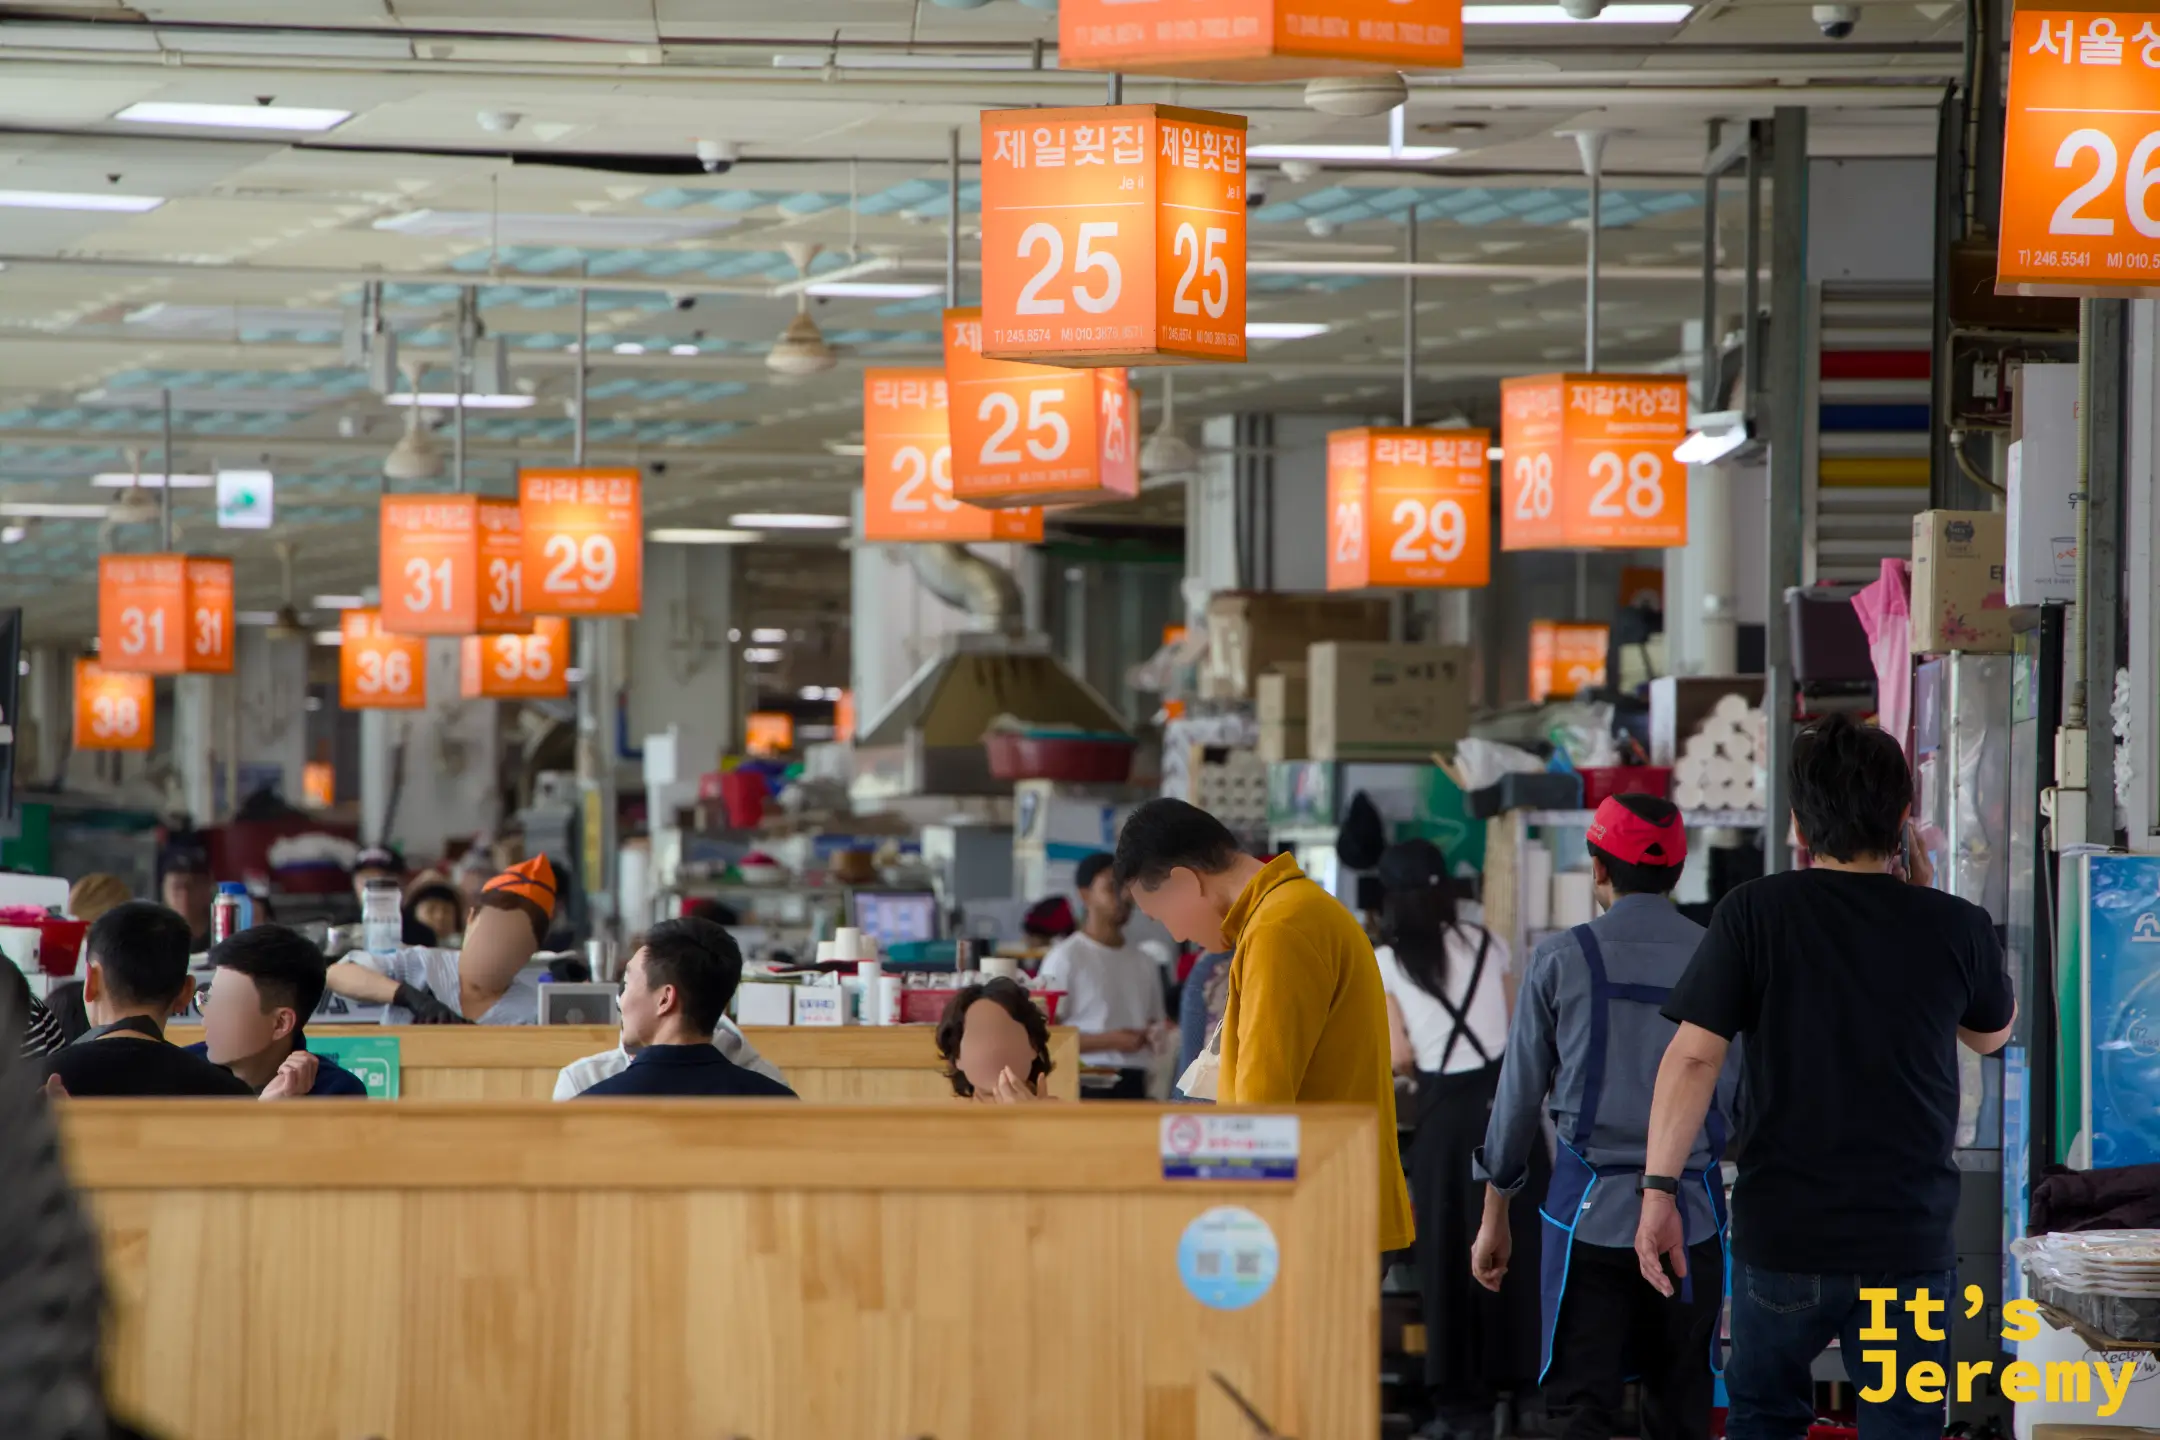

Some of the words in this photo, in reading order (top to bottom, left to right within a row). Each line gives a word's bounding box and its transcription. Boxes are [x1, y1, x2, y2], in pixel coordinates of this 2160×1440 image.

[993, 124, 1144, 169] 제일횟집
[1162, 126, 1240, 174] 제일횟집
[2049, 128, 2160, 238] 26
[1015, 222, 1122, 315] 25
[1173, 222, 1228, 318] 25
[2018, 249, 2030, 268] T)
[2034, 250, 2090, 267] 246.5541
[2107, 251, 2122, 268] M)
[977, 389, 1070, 465] 25
[890, 446, 960, 512] 29
[1514, 452, 1553, 519] 28
[1588, 451, 1665, 517] 28
[1334, 501, 1363, 563] 29
[1390, 500, 1467, 562] 29
[404, 558, 452, 612] 31
[488, 559, 522, 613] 31
[544, 533, 617, 592] 29
[120, 607, 165, 655] 31
[195, 608, 222, 655] 31
[494, 634, 553, 680] 35
[356, 648, 412, 693] 36
[92, 696, 140, 738] 38
